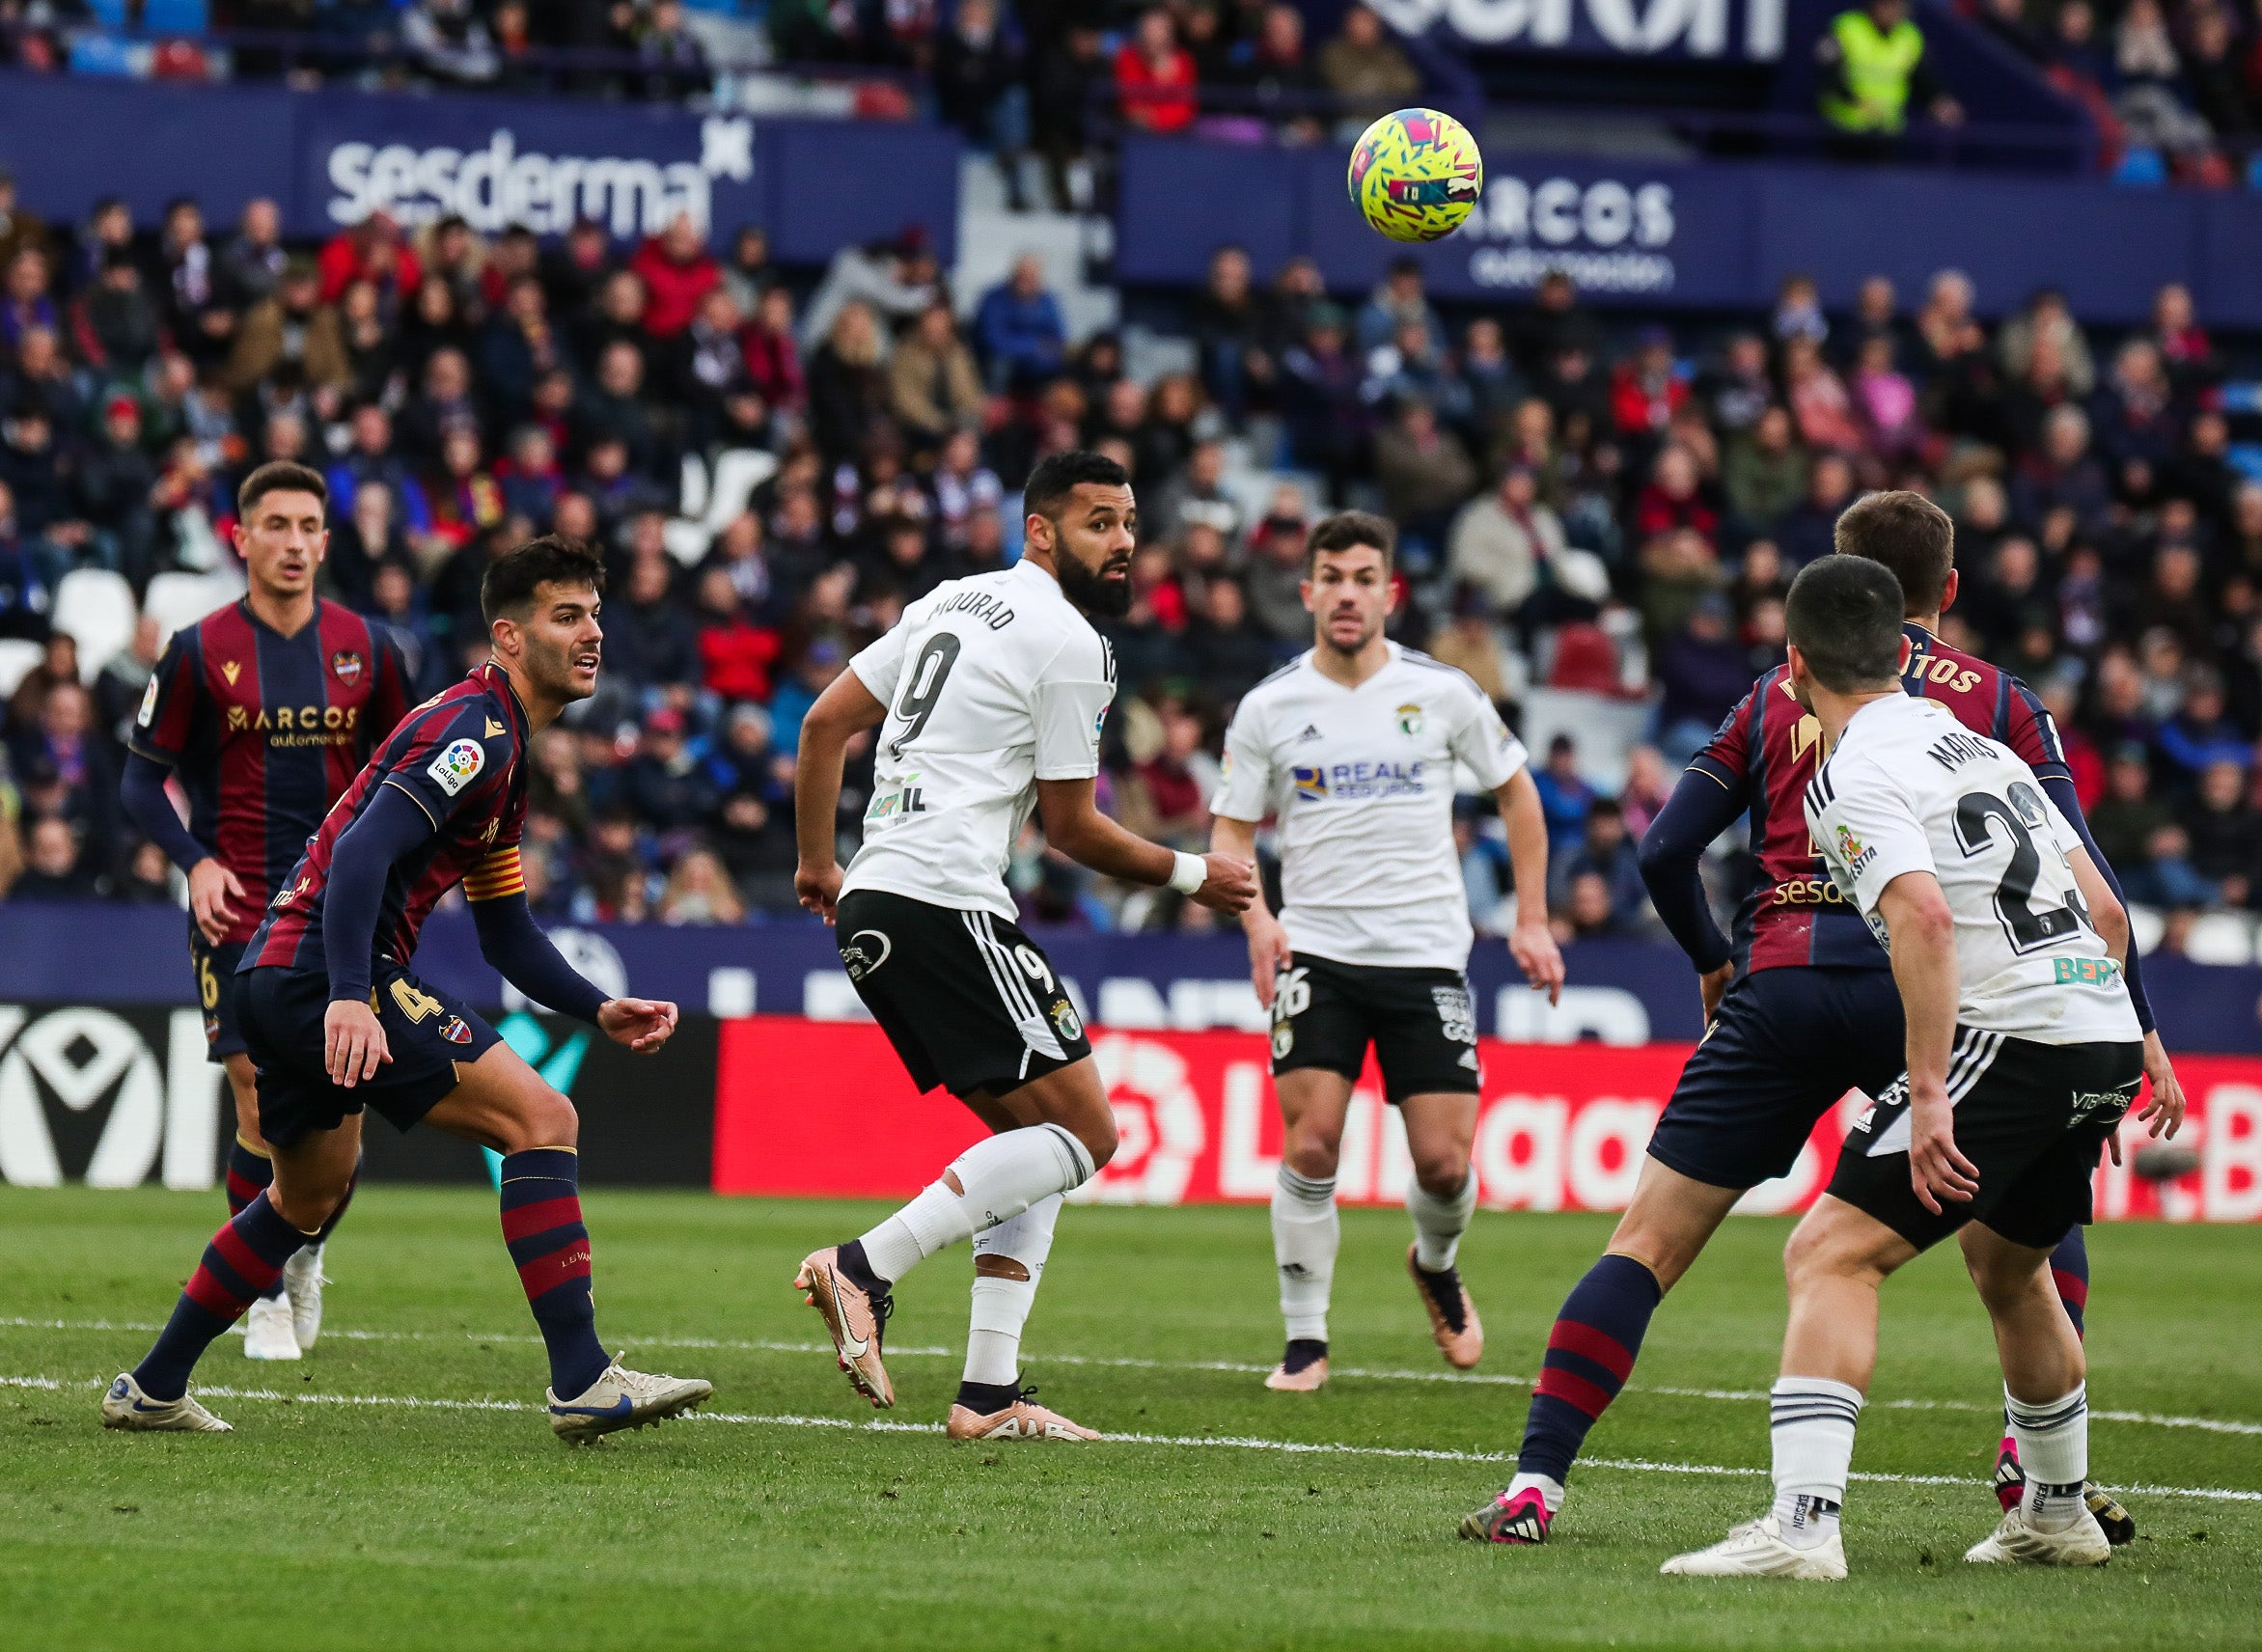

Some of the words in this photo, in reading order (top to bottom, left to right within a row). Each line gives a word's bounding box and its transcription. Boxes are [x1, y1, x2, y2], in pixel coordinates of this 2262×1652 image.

[927, 591, 1015, 631] MOURAD
[227, 704, 357, 730] MARCOS
[887, 631, 961, 762] 9
[1926, 731, 2000, 774] MATOS
[434, 762, 458, 789] LaLiga
[1014, 944, 1055, 994] 9
